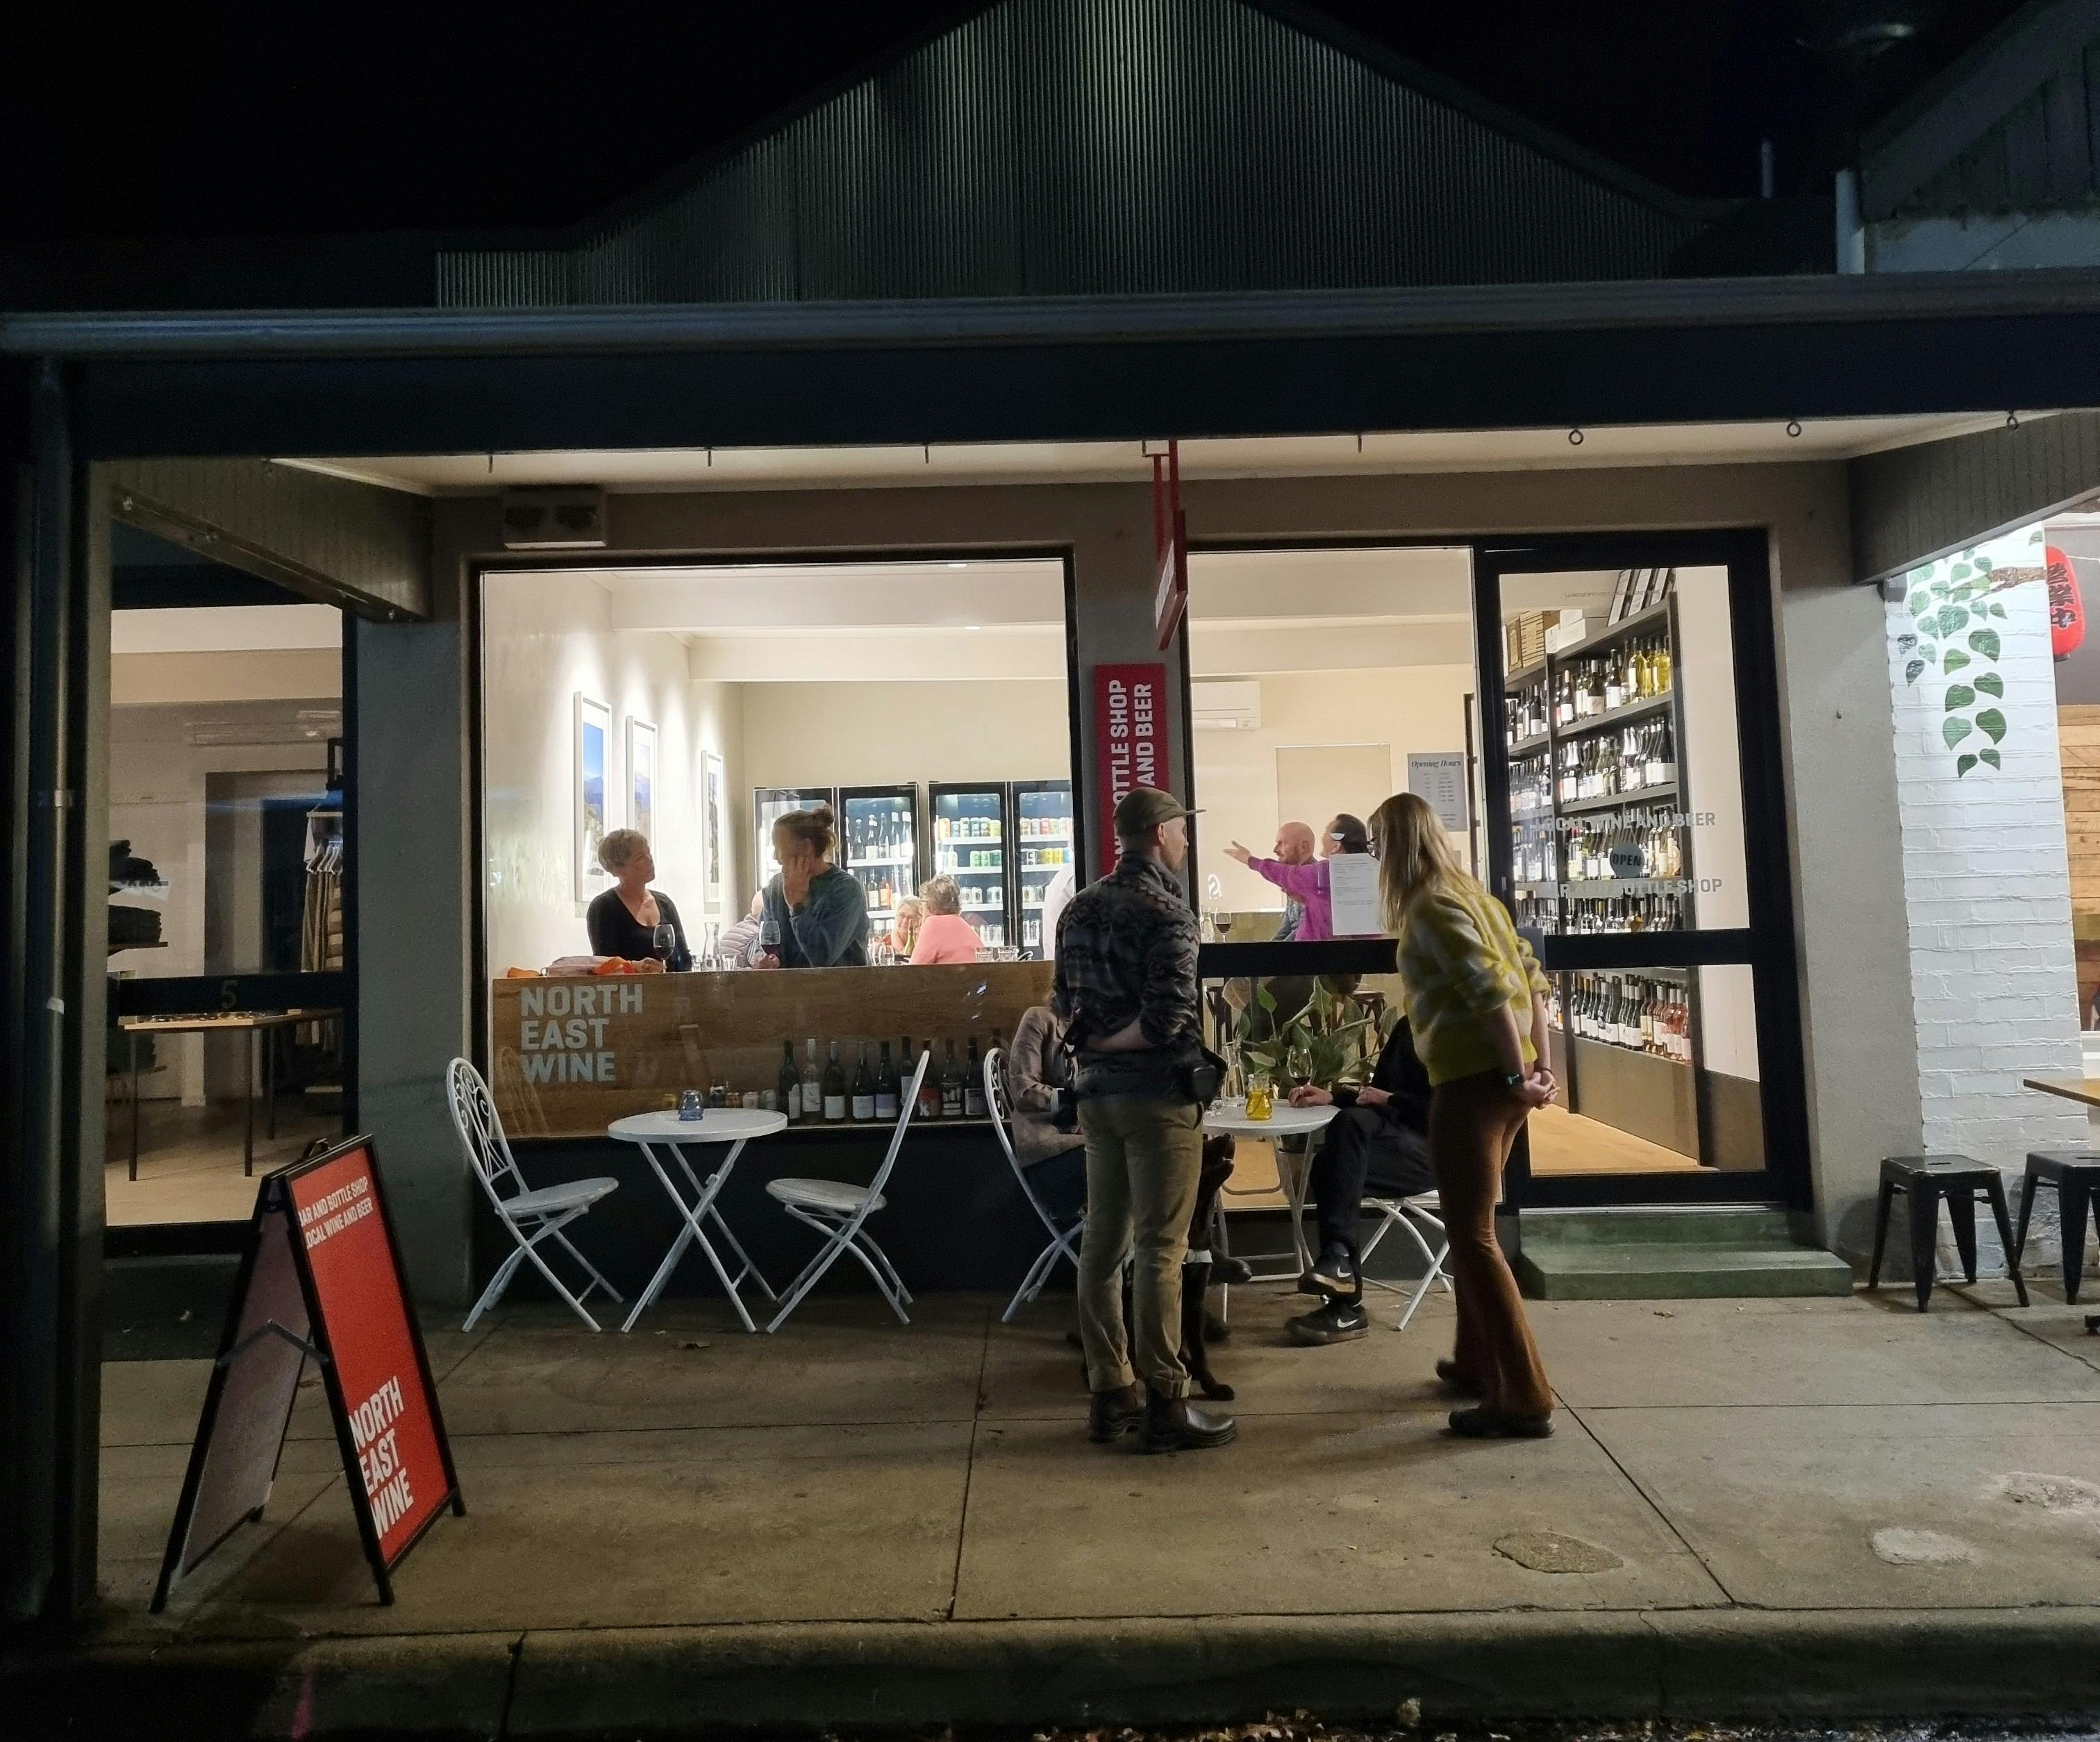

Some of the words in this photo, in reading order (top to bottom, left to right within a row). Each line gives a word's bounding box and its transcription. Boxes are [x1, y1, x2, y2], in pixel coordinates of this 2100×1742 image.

[1108, 679, 1129, 738] SHOP
[1133, 683, 1153, 737] BEER
[1111, 742, 1131, 805] OTTLE
[1135, 742, 1156, 787] AND
[1411, 760, 1440, 769] Opening
[1635, 813, 1669, 830] AND
[1673, 812, 1716, 828] BEER
[1612, 853, 1642, 866] OPEN
[1676, 878, 1722, 894] SHOP
[222, 980, 238, 1008] 5
[521, 983, 643, 1017] NORTH
[521, 1018, 610, 1050] EAST
[520, 1051, 616, 1083] WINE
[312, 1198, 329, 1220] AND
[326, 1184, 353, 1212] BOTTLE
[350, 1175, 368, 1198] SHOP
[306, 1224, 327, 1250] OCAL
[324, 1213, 345, 1237] WINE
[342, 1205, 358, 1226] AND
[356, 1196, 374, 1218] BEER
[348, 1375, 404, 1452] NORTH
[358, 1427, 399, 1497] EAST
[370, 1466, 413, 1539] WINE
